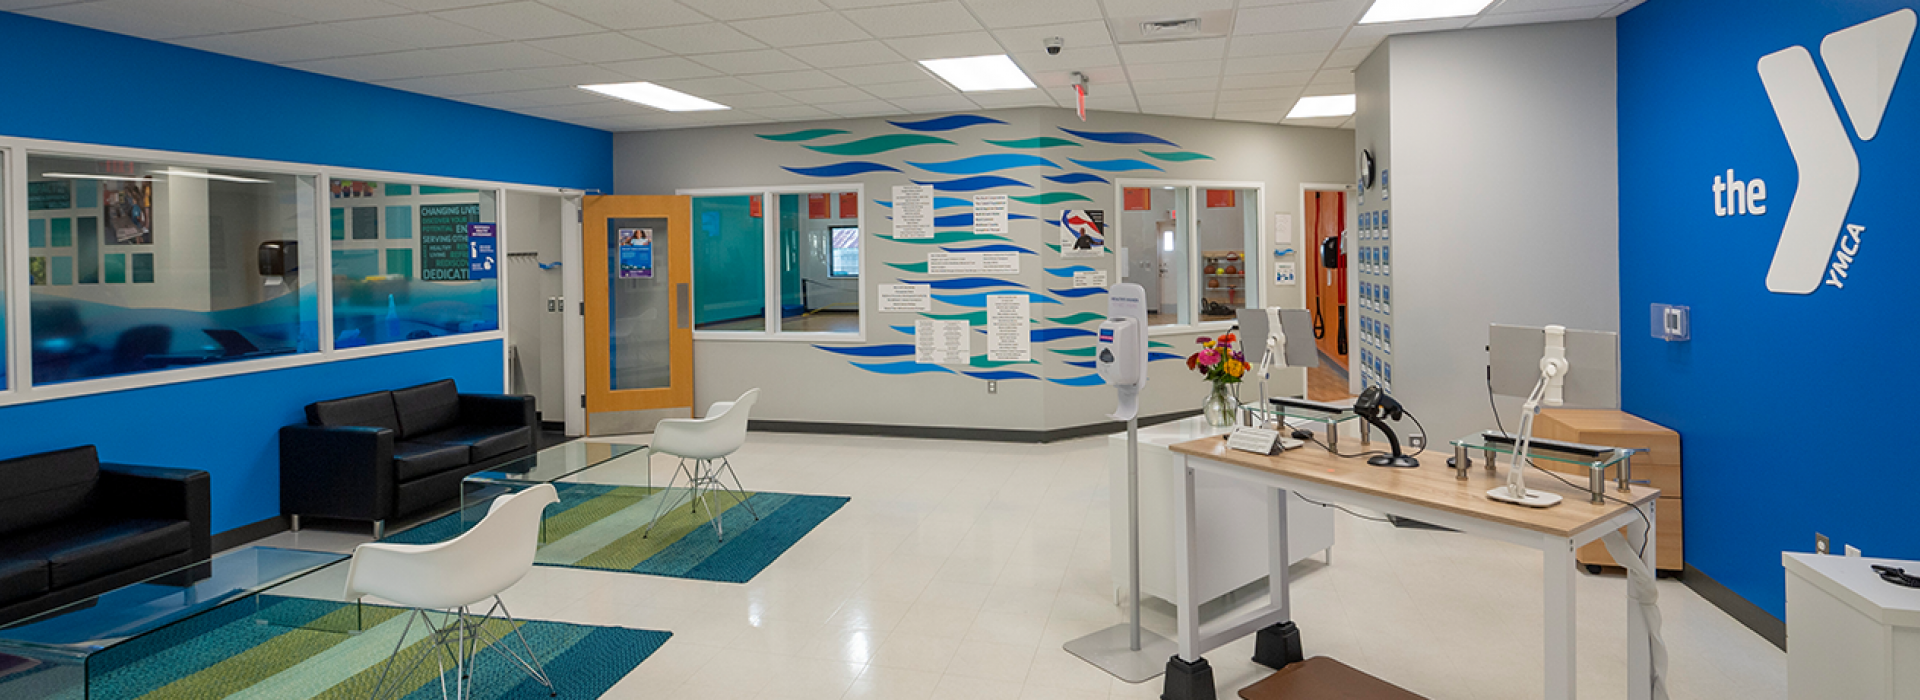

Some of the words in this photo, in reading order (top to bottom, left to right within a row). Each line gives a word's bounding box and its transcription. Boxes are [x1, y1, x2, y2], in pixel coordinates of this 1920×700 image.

[422, 207, 459, 216] CHANGING
[1712, 168, 1767, 217] the
[1825, 223, 1866, 289] YMCA
